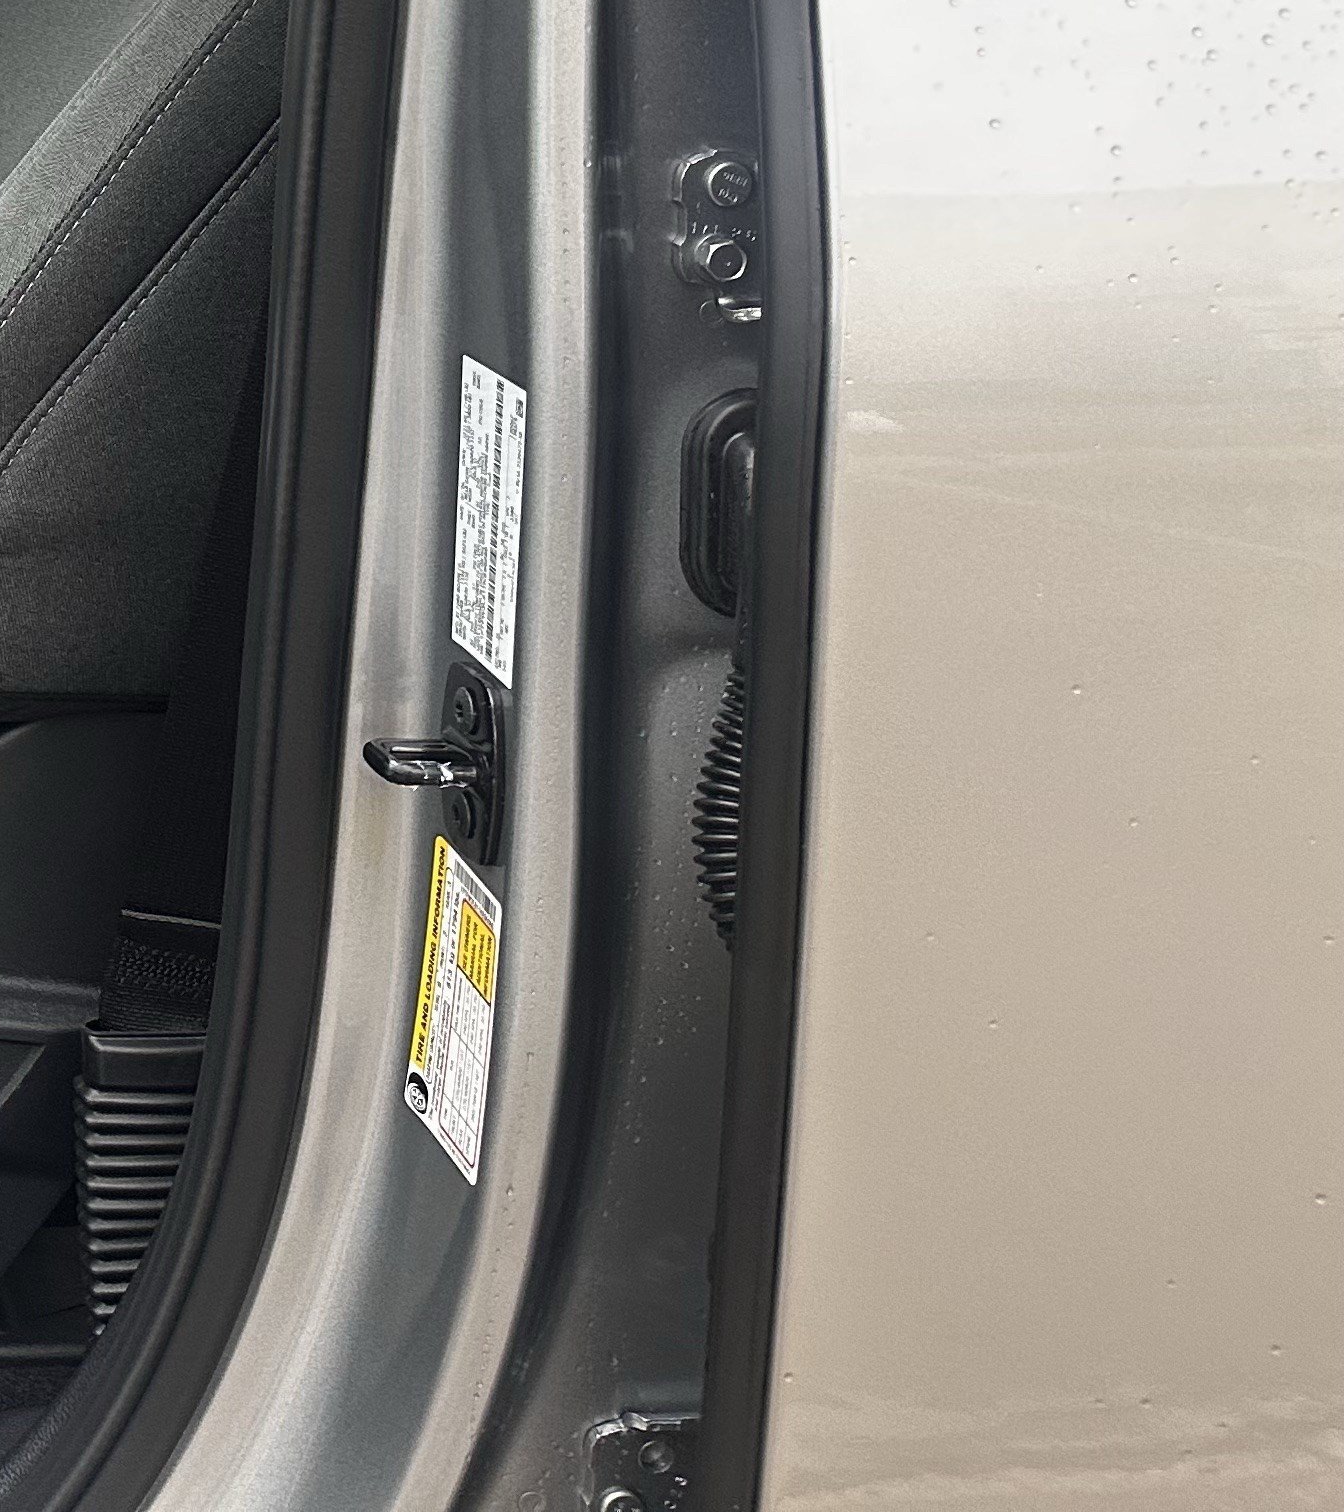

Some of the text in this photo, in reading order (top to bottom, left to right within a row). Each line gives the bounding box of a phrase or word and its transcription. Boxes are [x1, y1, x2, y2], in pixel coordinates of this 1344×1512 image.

[429, 843, 447, 940] INFORMATION
[423, 938, 436, 1002] LOADING
[419, 998, 429, 1032] AND
[415, 1030, 425, 1067] TIRE
